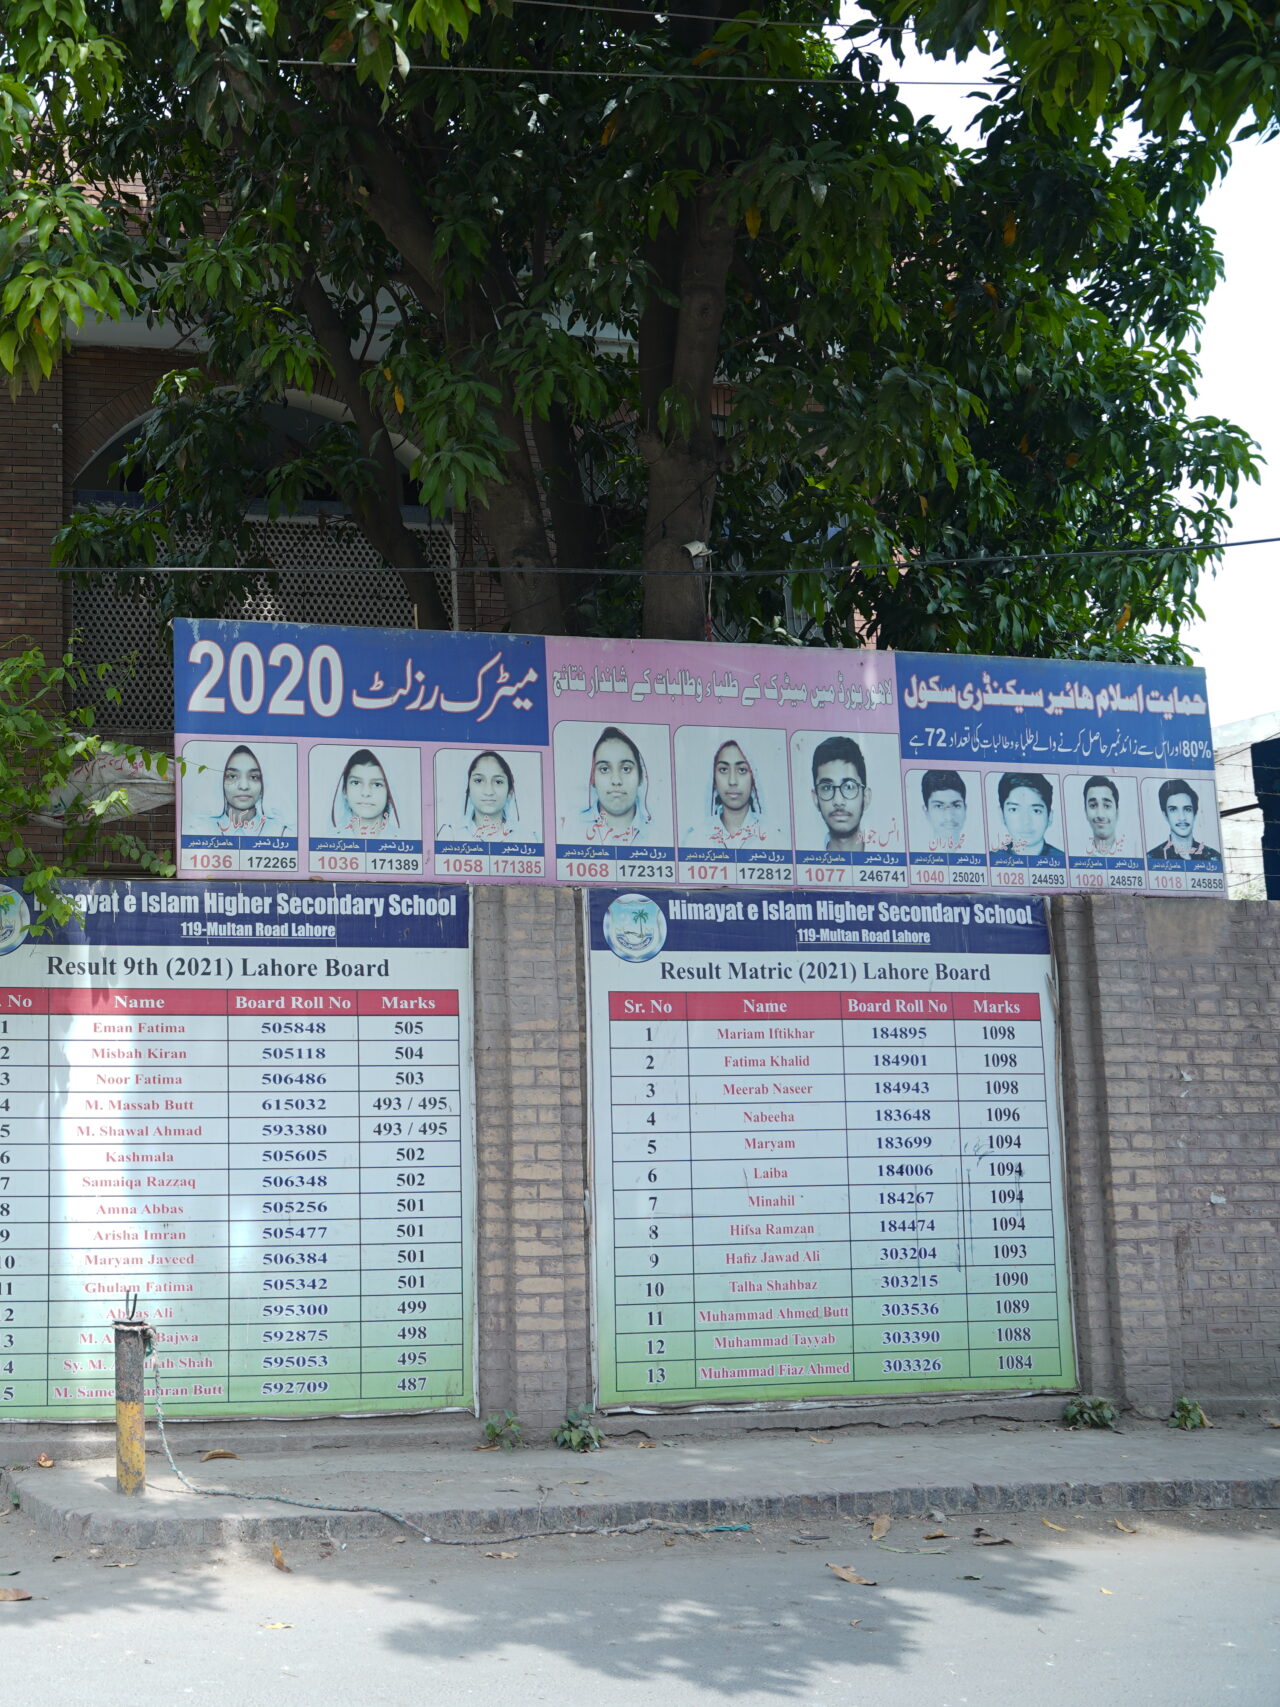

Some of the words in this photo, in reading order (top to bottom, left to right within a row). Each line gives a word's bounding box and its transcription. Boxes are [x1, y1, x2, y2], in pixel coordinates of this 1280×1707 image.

[188, 640, 344, 717] 2020
[352, 658, 439, 711] رزلٹ
[441, 652, 538, 721] میٹرک
[905, 674, 956, 708] سکول
[1096, 684, 1144, 718] اسلام
[925, 728, 946, 747] 72
[1183, 741, 1211, 758] 80%
[191, 854, 232, 868] 1036
[248, 857, 296, 868] 172265
[319, 856, 359, 870] 1036
[372, 859, 418, 870] 171389
[444, 859, 483, 872] 1058
[494, 860, 541, 874] 171385
[566, 863, 609, 877] 1068
[620, 865, 673, 877] 172313
[688, 866, 727, 880] 1071
[740, 868, 791, 880] 172812
[805, 868, 845, 882] 1077
[860, 870, 905, 882] 246741
[917, 870, 944, 882] 1040
[953, 872, 984, 883] 250201
[997, 873, 1024, 885] 1028
[1032, 874, 1064, 884] 244593
[1076, 874, 1103, 886] 1020
[1111, 875, 1142, 886] 248578
[1155, 876, 1182, 888] 1018
[1192, 878, 1223, 889] 245858
[124, 897, 136, 914] e
[141, 893, 199, 914] Islam
[204, 893, 272, 916] Higher
[277, 895, 384, 918] Secondary
[388, 896, 456, 916] School
[669, 901, 744, 922] Himayat
[747, 903, 759, 920] e
[763, 901, 813, 921] Islam
[817, 901, 875, 924] Higher
[879, 902, 971, 925] Secondary
[974, 904, 1032, 925] School
[181, 922, 250, 937] 119-Multan
[255, 923, 286, 937] Road
[291, 924, 336, 938] Lahore
[797, 928, 860, 943] 119-Multan
[862, 929, 889, 942] Road
[892, 930, 930, 944] Lahore
[47, 957, 119, 976] Result
[124, 957, 160, 976] 9th
[165, 956, 234, 981] (2021)
[241, 958, 318, 977] Lahore
[325, 959, 389, 978] Board
[660, 962, 721, 981] Result
[728, 963, 793, 981] Matric
[798, 962, 857, 984] (2021)
[863, 963, 929, 981] Lahore
[935, 963, 990, 981] Board
[8, 995, 32, 1007] No
[114, 996, 164, 1008] Name
[236, 996, 283, 1009] Board
[290, 996, 323, 1009] Roll
[328, 996, 351, 1009] No
[382, 997, 435, 1008] Marks
[625, 1000, 645, 1013] Sr.
[651, 1000, 672, 1013] No
[744, 1000, 787, 1012] Name
[848, 999, 890, 1012] Board
[896, 1000, 923, 1012] Roll
[928, 1000, 947, 1012] No
[974, 1000, 1020, 1013] Marks
[2, 1021, 7, 1033] 1
[93, 1022, 134, 1033] Eman
[139, 1022, 185, 1033] Fatima
[262, 1023, 325, 1033] 505848
[395, 1022, 423, 1034] 505
[718, 1029, 764, 1039] Mariam
[770, 1028, 814, 1039] Iftikhar
[873, 1027, 926, 1039] 184895
[983, 1026, 1015, 1040] 1098
[647, 1028, 652, 1041] 1
[1, 1046, 9, 1059] 2
[92, 1048, 142, 1059] Misbah
[147, 1047, 187, 1059] Kiran
[263, 1048, 325, 1059] 505118
[395, 1047, 423, 1059] 504
[0, 1072, 10, 1085] 3
[97, 1074, 130, 1084] Noor
[135, 1073, 182, 1085] Fatima
[262, 1074, 326, 1084] 506486
[396, 1072, 423, 1085] 503
[646, 1083, 655, 1097] 3
[724, 1084, 768, 1095] Meerab
[773, 1083, 812, 1094] Naseer
[876, 1082, 929, 1093] 184943
[987, 1081, 1018, 1094] 1098
[882, 1303, 938, 1316] 303536
[997, 1300, 1029, 1313] 1089
[649, 1312, 662, 1325] 11
[699, 1308, 774, 1322] Muhammad
[777, 1306, 820, 1320] Ahmed
[823, 1306, 848, 1317] Butt
